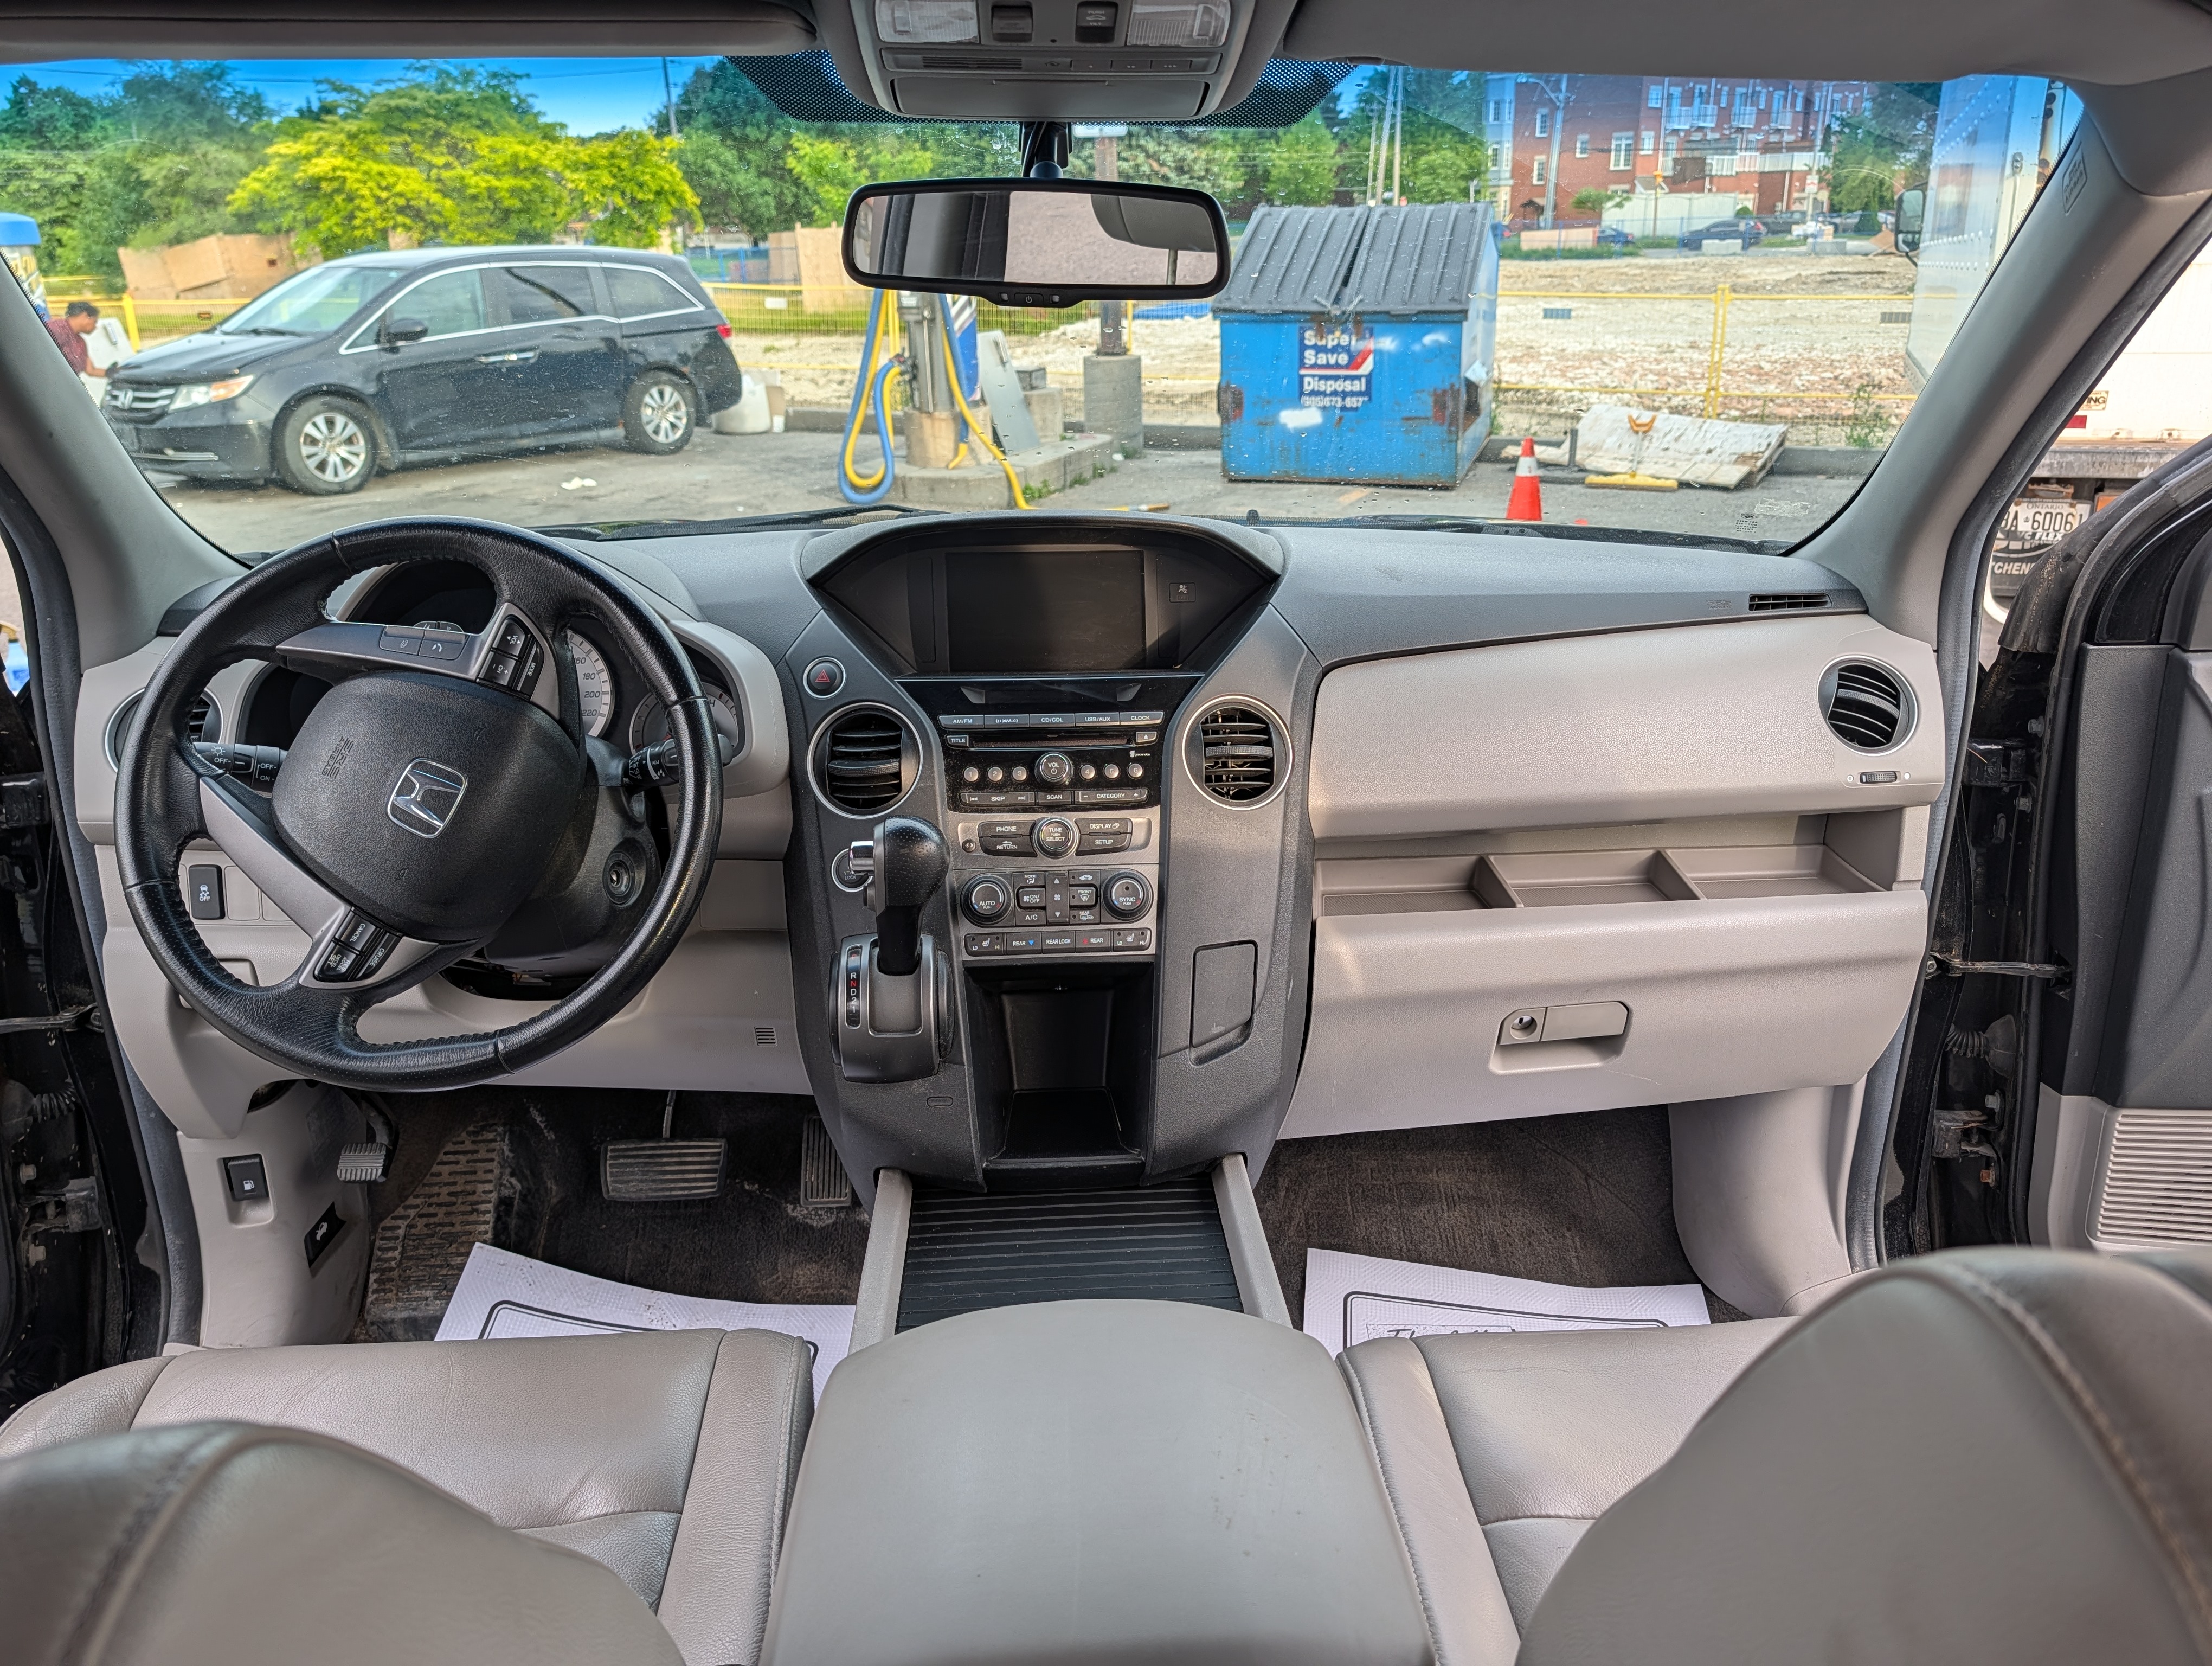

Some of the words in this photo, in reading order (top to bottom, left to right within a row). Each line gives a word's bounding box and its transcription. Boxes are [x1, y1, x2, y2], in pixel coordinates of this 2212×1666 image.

[1303, 349, 1349, 365] Save
[1303, 376, 1367, 395] Disposal
[1301, 395, 1369, 408] (905)673-657
[2086, 396, 2106, 405] ING
[510, 635, 518, 645] VOL
[497, 664, 504, 674] CH
[526, 662, 536, 676] MODE
[349, 923, 365, 942] CANCEL
[369, 948, 385, 967] CRUISE
